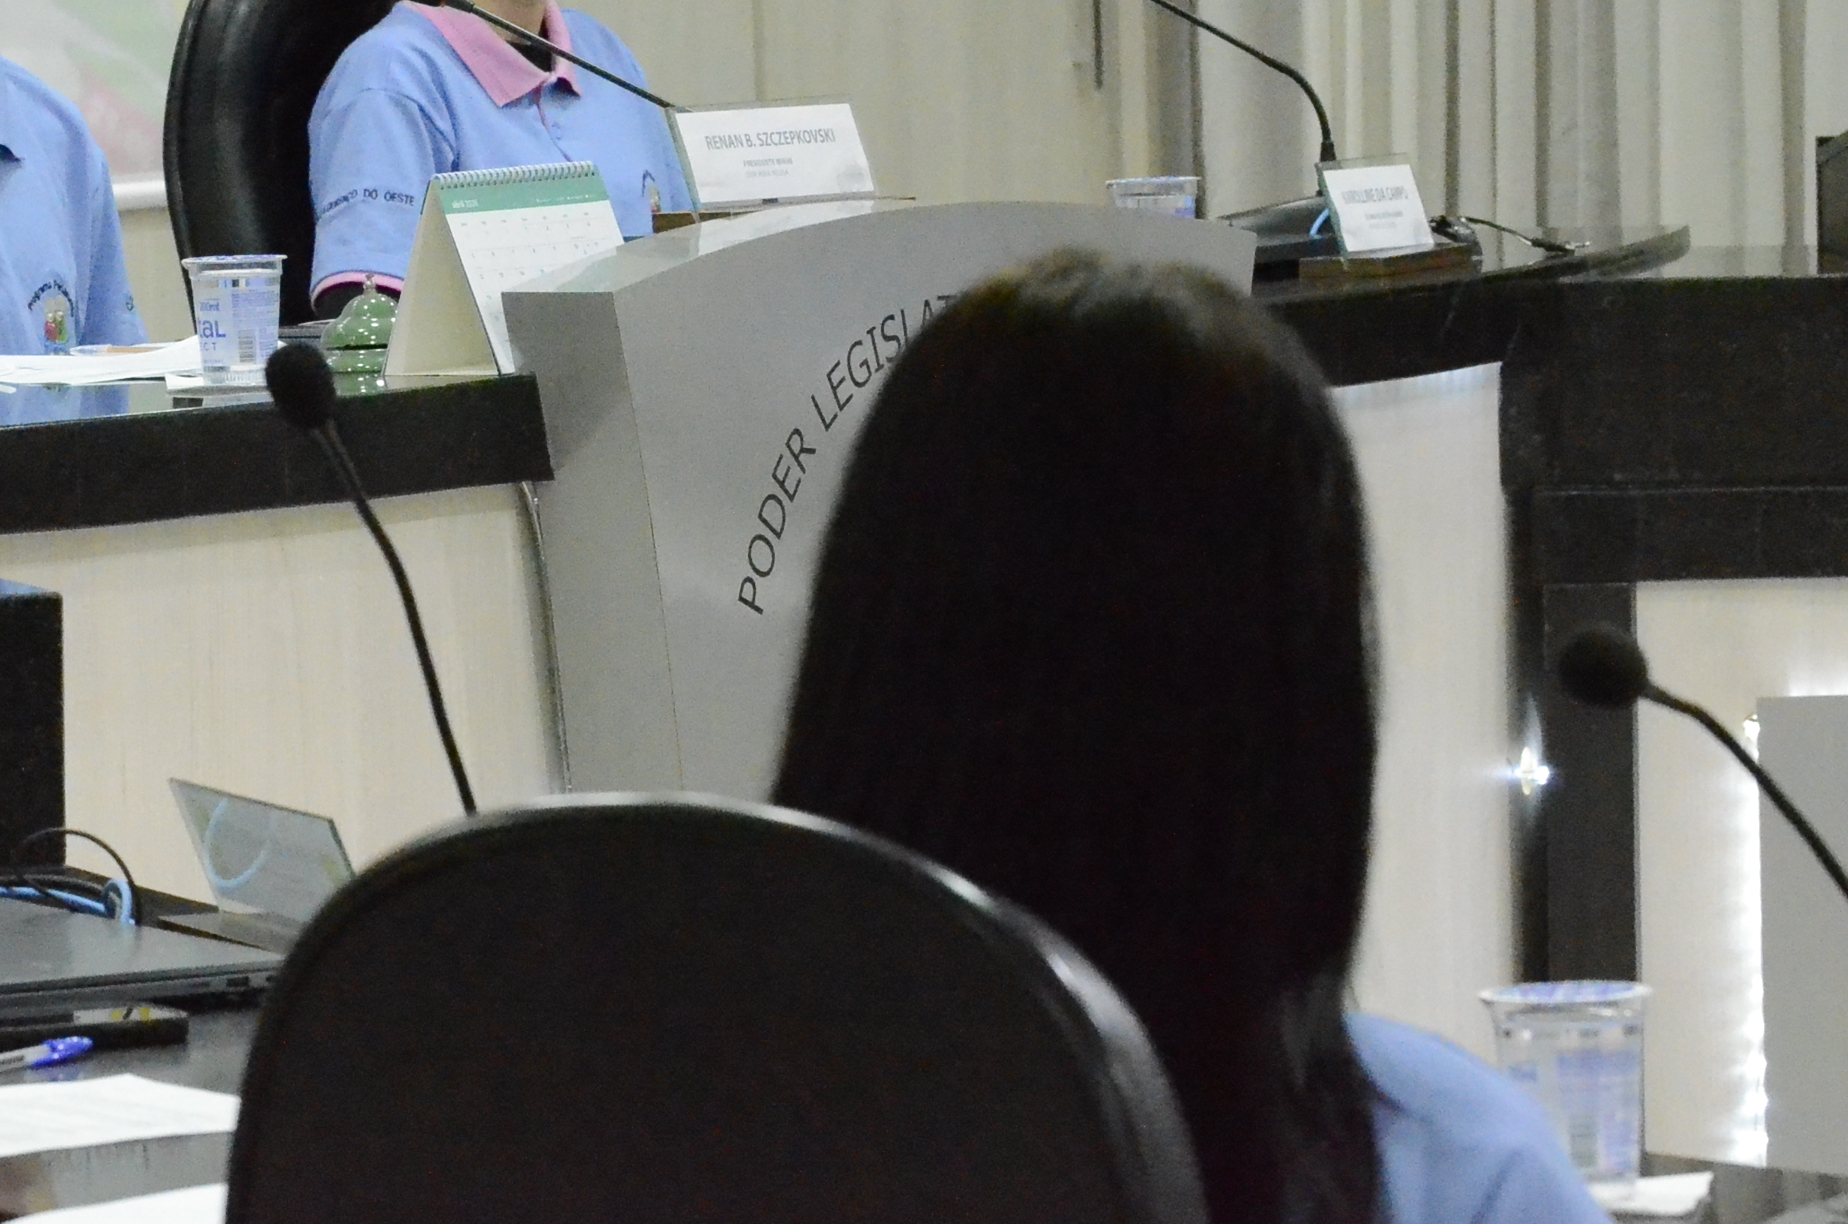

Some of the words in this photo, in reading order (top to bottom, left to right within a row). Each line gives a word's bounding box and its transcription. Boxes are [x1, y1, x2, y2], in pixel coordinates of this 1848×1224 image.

[704, 133, 745, 151] RENAN
[746, 132, 756, 148] B.
[757, 127, 837, 148] SZCZEPKOVSKI
[363, 187, 379, 201] DO
[383, 189, 416, 207] OESTE
[736, 427, 817, 616] PODER
